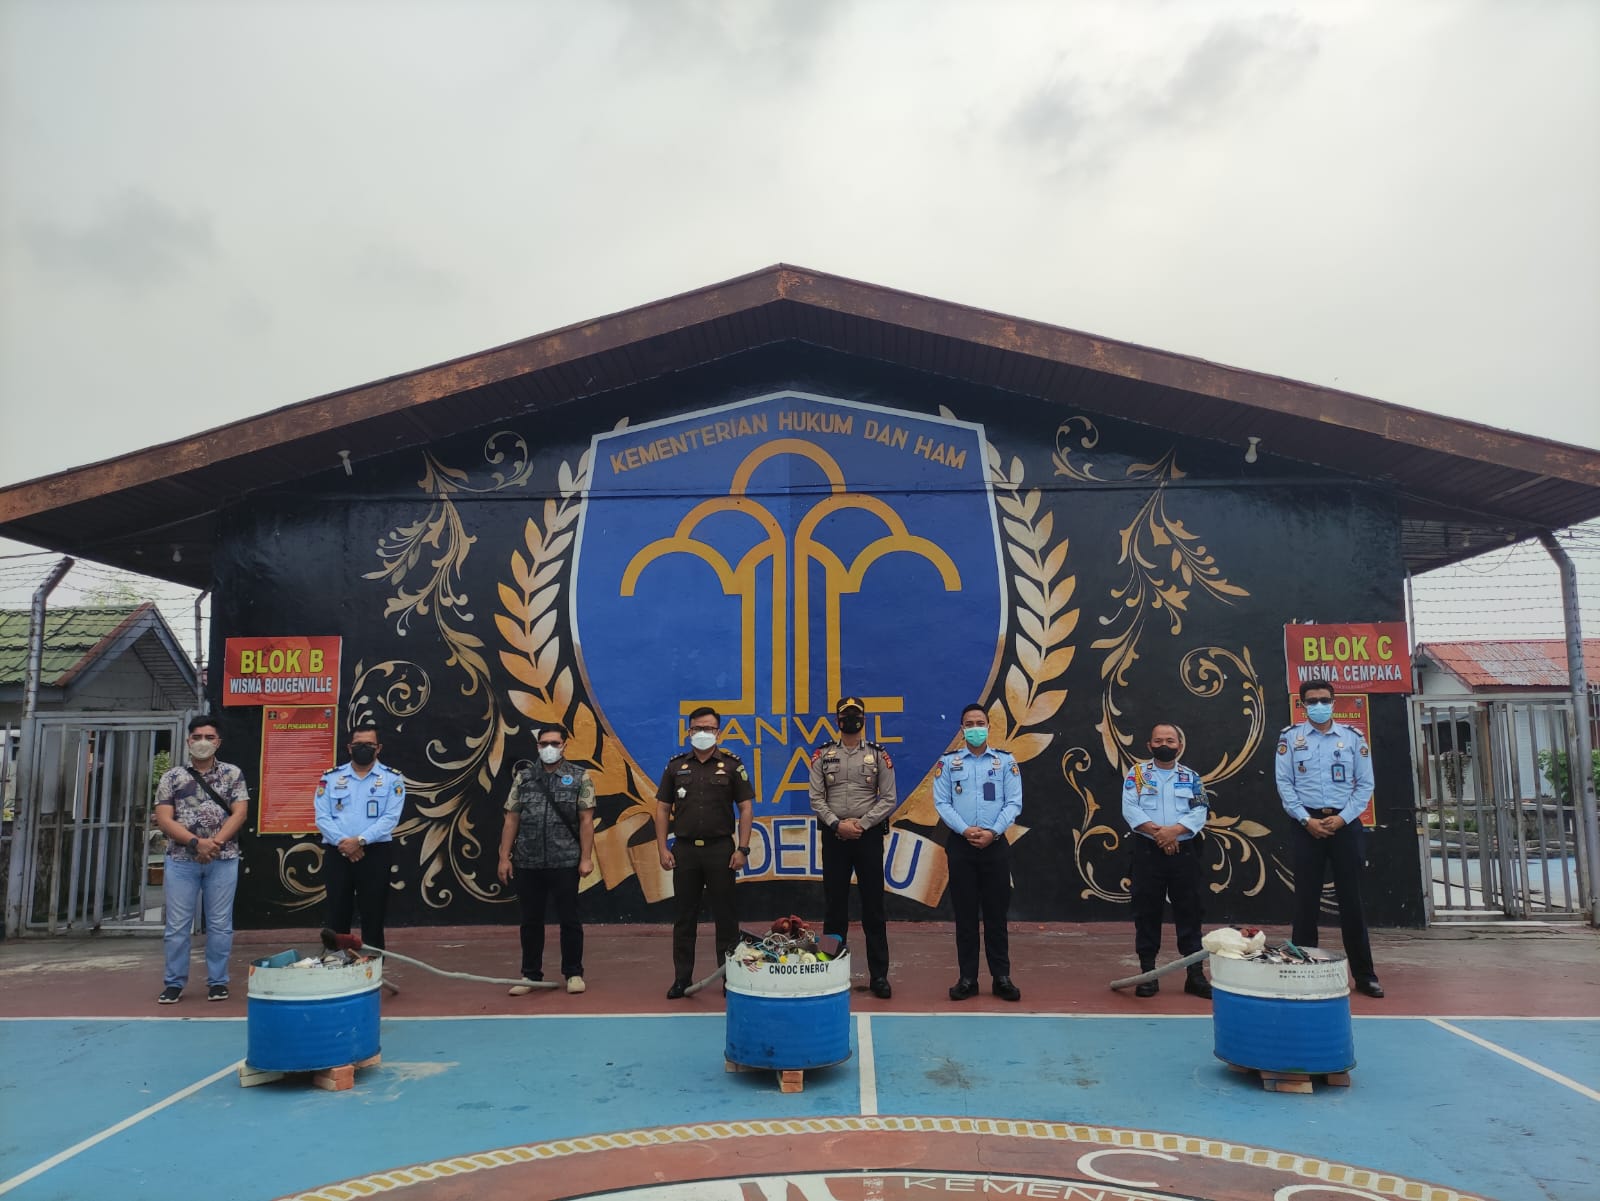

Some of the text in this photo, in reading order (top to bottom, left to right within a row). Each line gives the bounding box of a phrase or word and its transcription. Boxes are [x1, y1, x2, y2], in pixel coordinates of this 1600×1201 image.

[609, 411, 967, 474] KEMENTERIAN HUKUM DAN HAM
[1303, 635, 1393, 661] BLOK C
[240, 649, 324, 674] BLOK B
[1297, 664, 1402, 682] WISMA CEMPAKA
[230, 677, 333, 693] WISMA BOUGENVILLE
[679, 715, 904, 747] ANWL
[769, 963, 830, 975] CNOOC ENERGY
